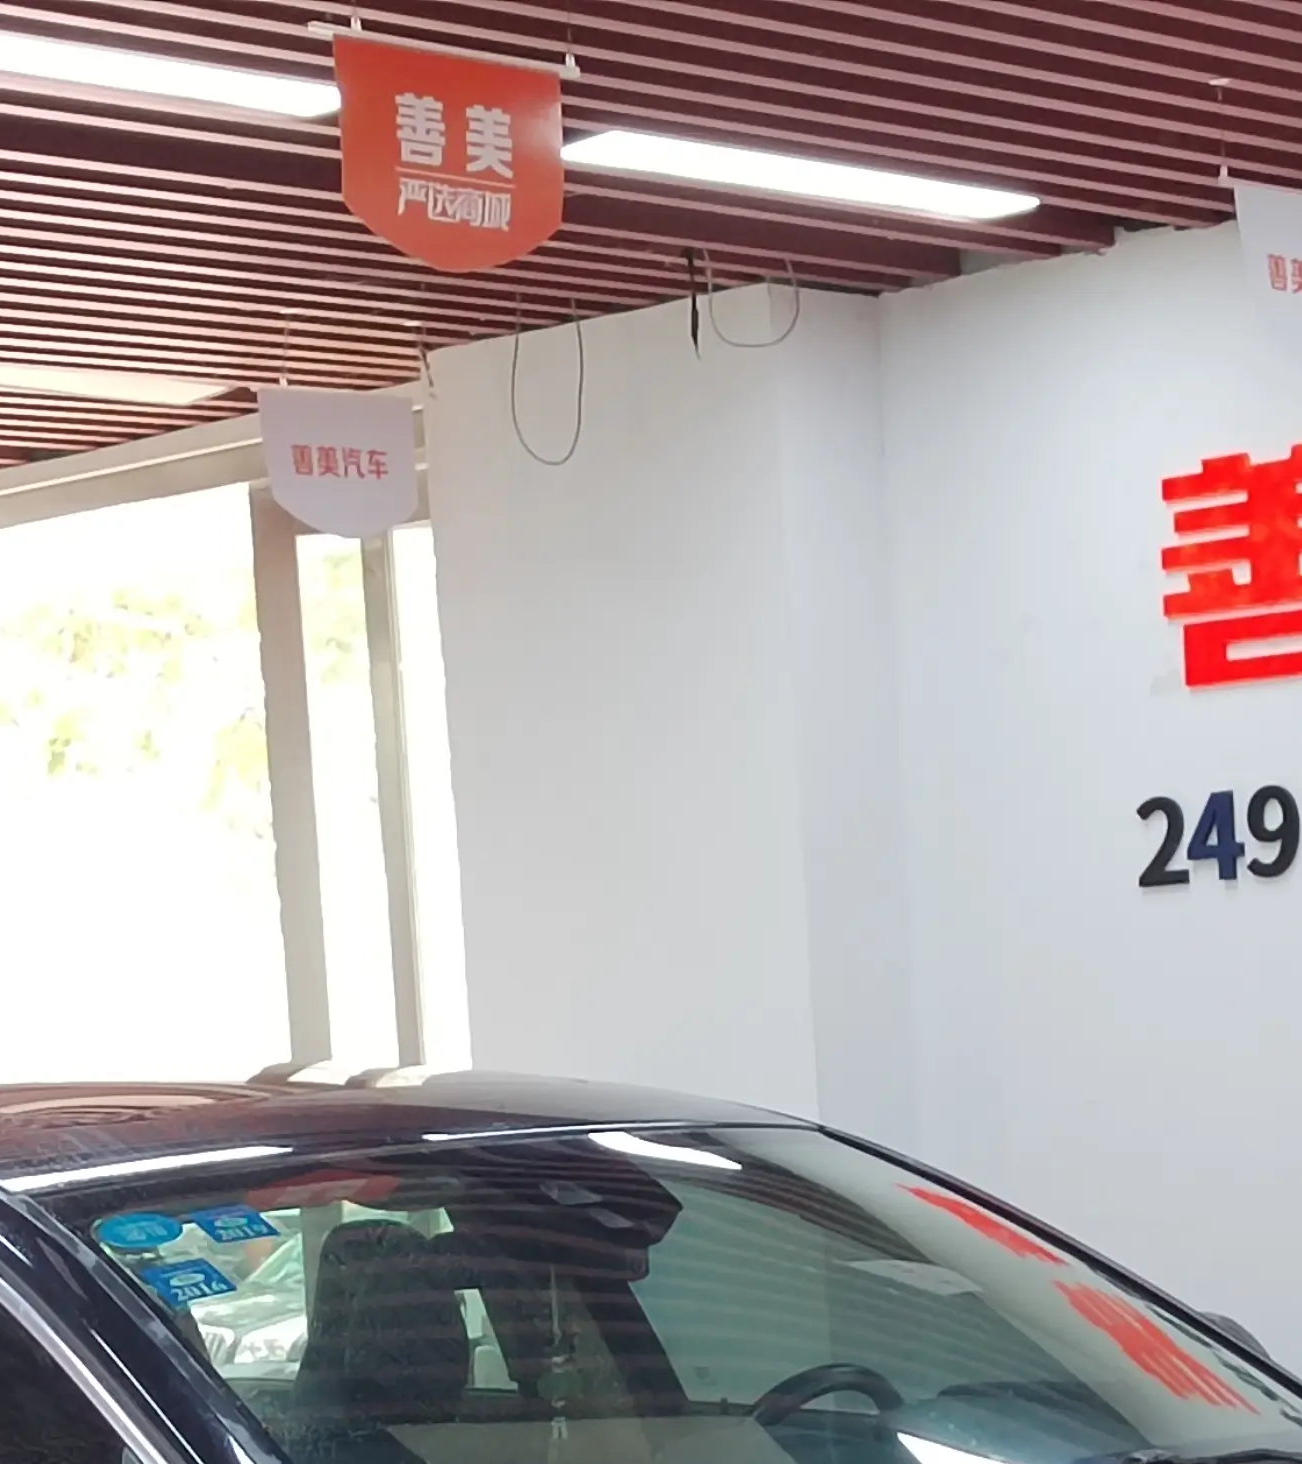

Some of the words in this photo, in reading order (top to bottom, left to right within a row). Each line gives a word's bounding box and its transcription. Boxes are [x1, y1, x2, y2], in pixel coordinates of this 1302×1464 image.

[395, 92, 514, 179] 善美
[289, 443, 389, 480] 善美汽车
